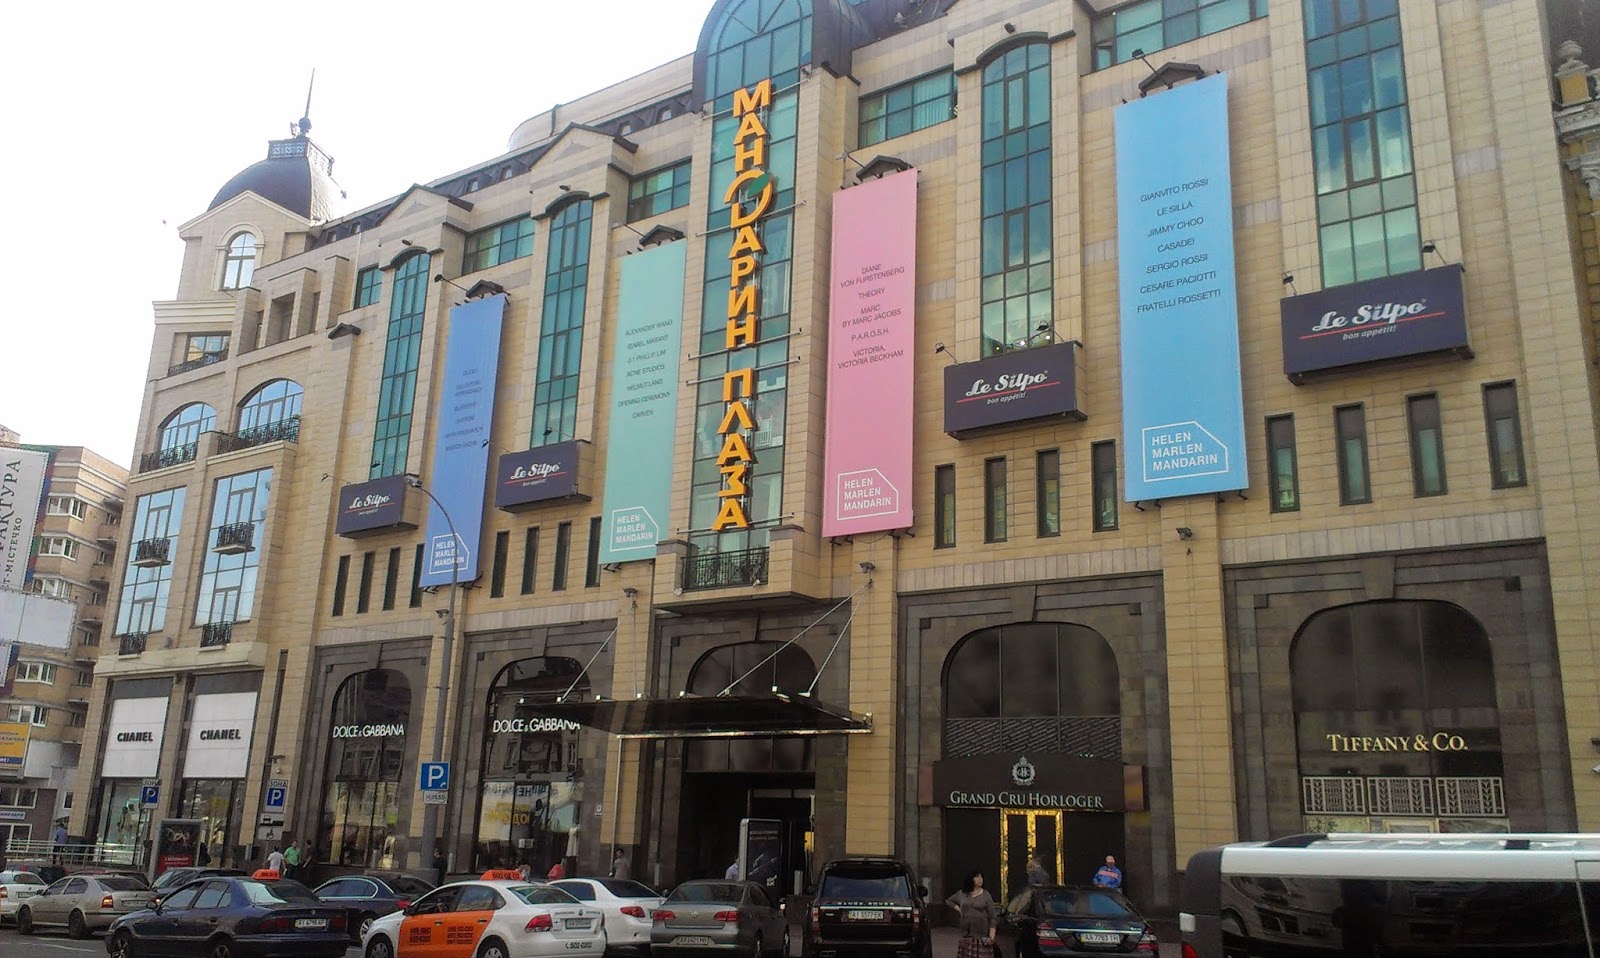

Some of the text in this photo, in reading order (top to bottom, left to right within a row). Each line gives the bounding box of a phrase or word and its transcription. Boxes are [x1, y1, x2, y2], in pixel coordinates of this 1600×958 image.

[1141, 178, 1208, 202] GIANVITO ROSSI
[1157, 201, 1193, 216] LE SILLA
[1148, 217, 1204, 237] JIMMY CHOO
[1157, 238, 1195, 253] CASADEI
[861, 264, 881, 274] DIANE
[1146, 253, 1208, 274] SERGIO ROSSI
[840, 266, 905, 288] VON FURSTENBERG
[1140, 271, 1216, 294] CESARE PACIOTTI
[859, 287, 885, 299] THEORY
[1137, 289, 1221, 313] FRATELLI ROSSETTI
[860, 304, 881, 314] MARC
[1312, 301, 1427, 332] Le Silpo
[842, 308, 901, 328] BY MARC JACOBS
[1342, 332, 1360, 341] bon
[838, 350, 904, 369] VICTORIA BECKHAM
[965, 371, 1048, 396] Le Silpo
[986, 397, 999, 405] bon
[1152, 431, 1191, 446] HELEN
[712, 368, 753, 531] ПЛАЗА
[1152, 443, 1202, 458] MARLEN
[1153, 454, 1218, 471] MANDARIN
[510, 466, 527, 480] Le
[844, 477, 873, 489] HELEN
[844, 487, 881, 500] MARLEN
[349, 497, 363, 509] Le
[844, 497, 891, 511] MANDARIN
[617, 514, 640, 524] HELEN
[616, 523, 646, 533] MARLEN
[616, 532, 653, 544] MANDARIN
[333, 725, 359, 738] DOLCE
[363, 723, 405, 738] GABBANA
[493, 718, 524, 733] DOLCE
[117, 732, 153, 742] CHANEL
[200, 729, 241, 740] CHANEL
[1413, 733, 1430, 752] &
[428, 765, 444, 788] P
[145, 788, 156, 801] P
[271, 789, 281, 805] P
[950, 791, 1104, 808] GRAND CRU HORLOGER
